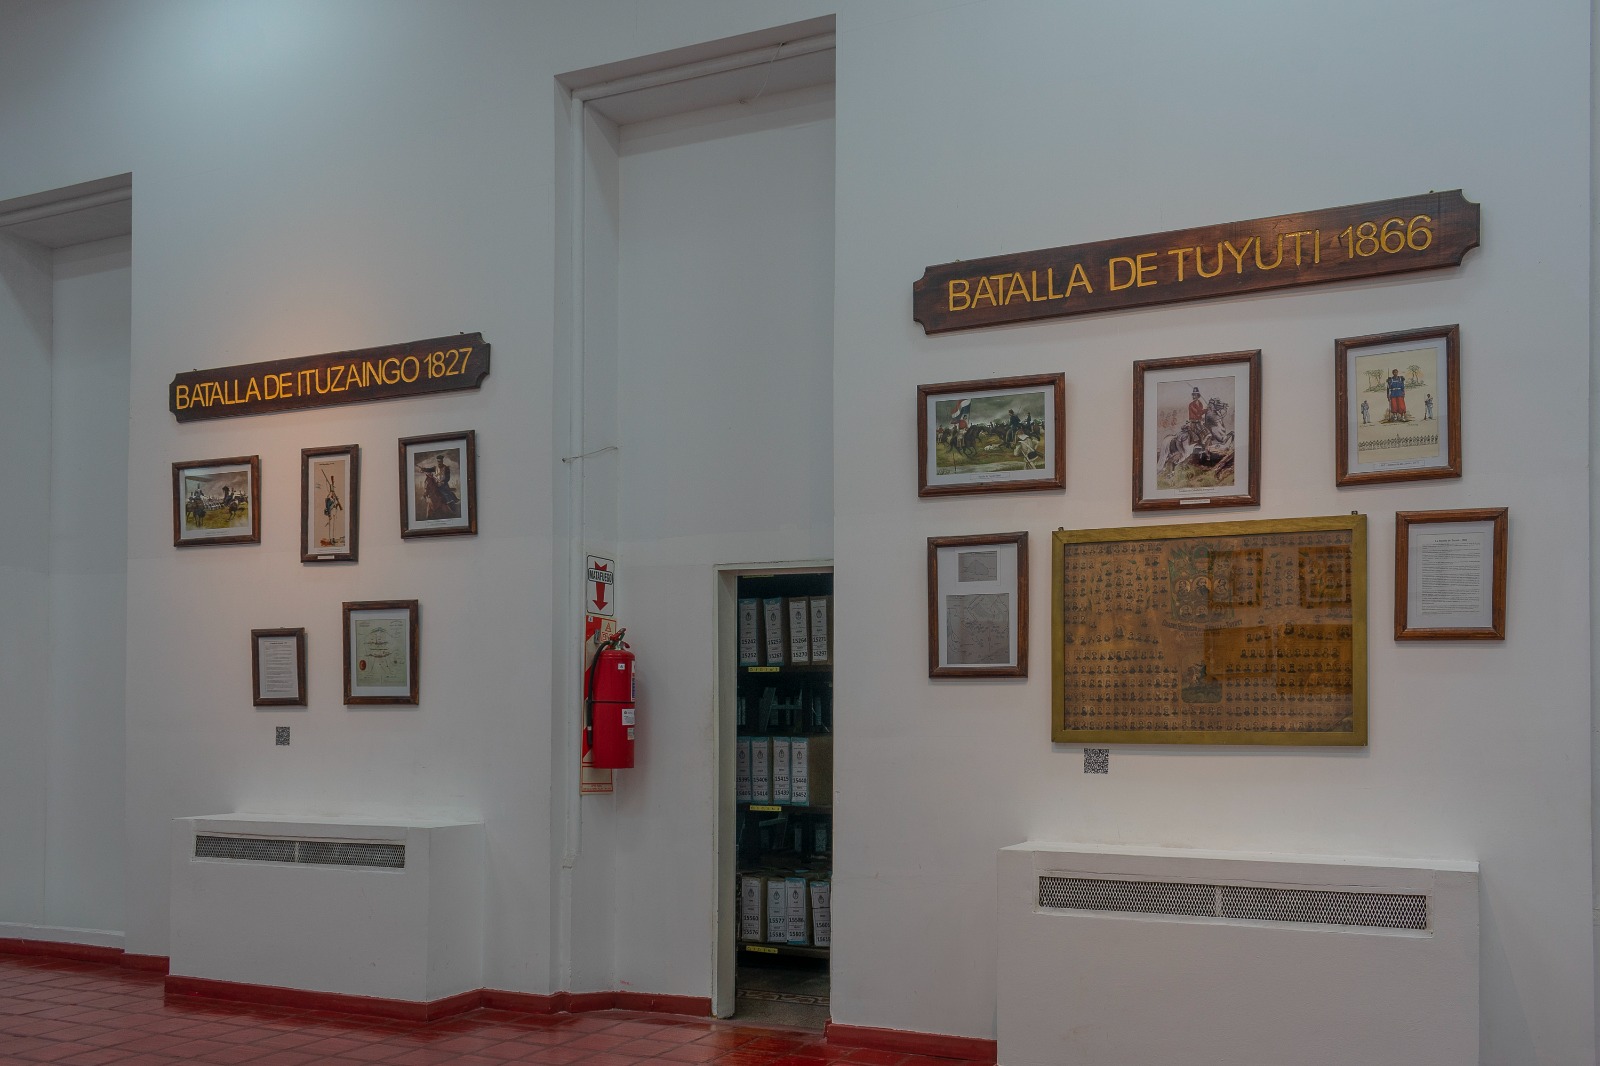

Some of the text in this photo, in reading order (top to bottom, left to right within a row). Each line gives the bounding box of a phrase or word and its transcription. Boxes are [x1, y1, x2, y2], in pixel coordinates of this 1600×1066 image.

[948, 213, 1434, 313] BATALLA DE TUYUTI 1866
[176, 347, 473, 410] BATALLA DE ITUZAINGO 1827
